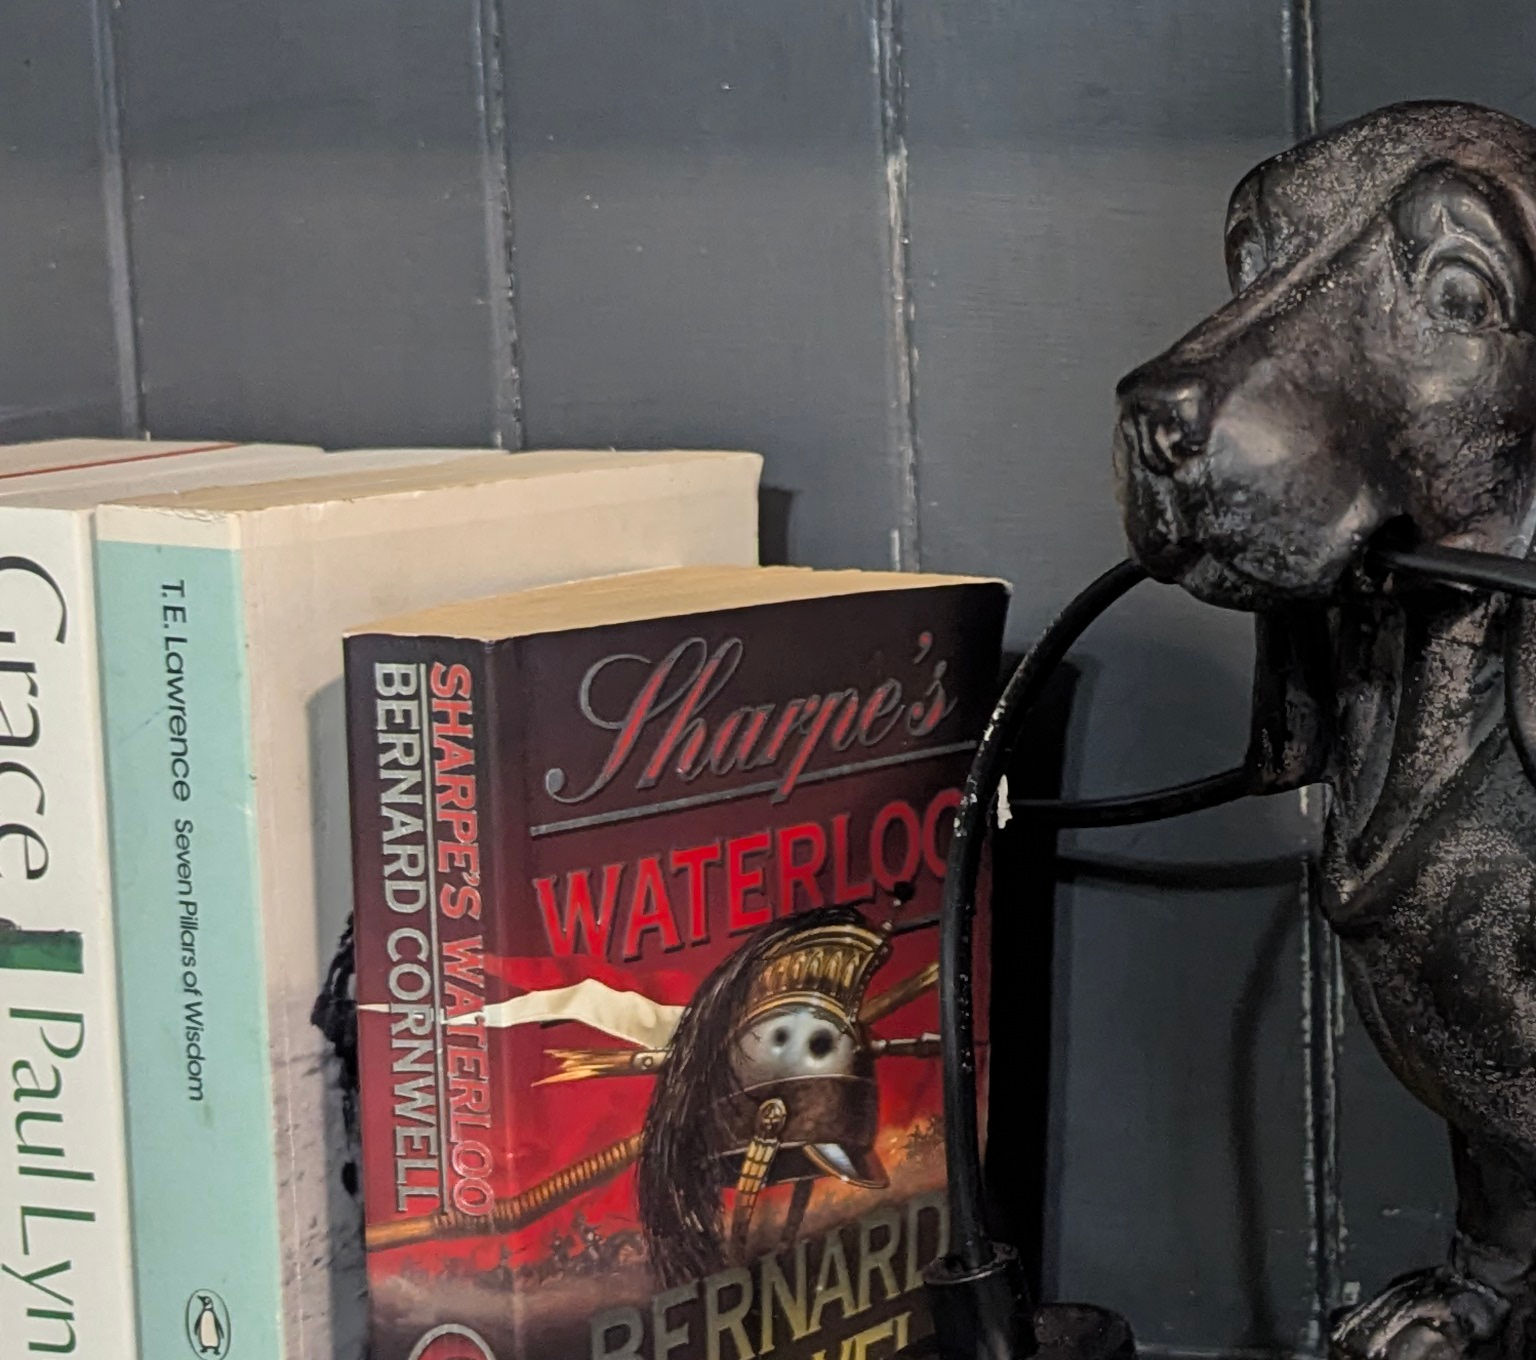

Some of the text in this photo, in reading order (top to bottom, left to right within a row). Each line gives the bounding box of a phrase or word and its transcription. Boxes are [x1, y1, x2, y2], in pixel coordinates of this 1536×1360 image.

[161, 579, 192, 803] T. E. Lawrence
[545, 630, 959, 804] Sharpe's
[173, 818, 206, 1103] Seven Pillars of Wisdom
[375, 662, 439, 1212] BERNARD CORNWELL
[430, 660, 495, 1217] SHARPE'S WATERLOO
[9, 1007, 97, 1182] Paul
